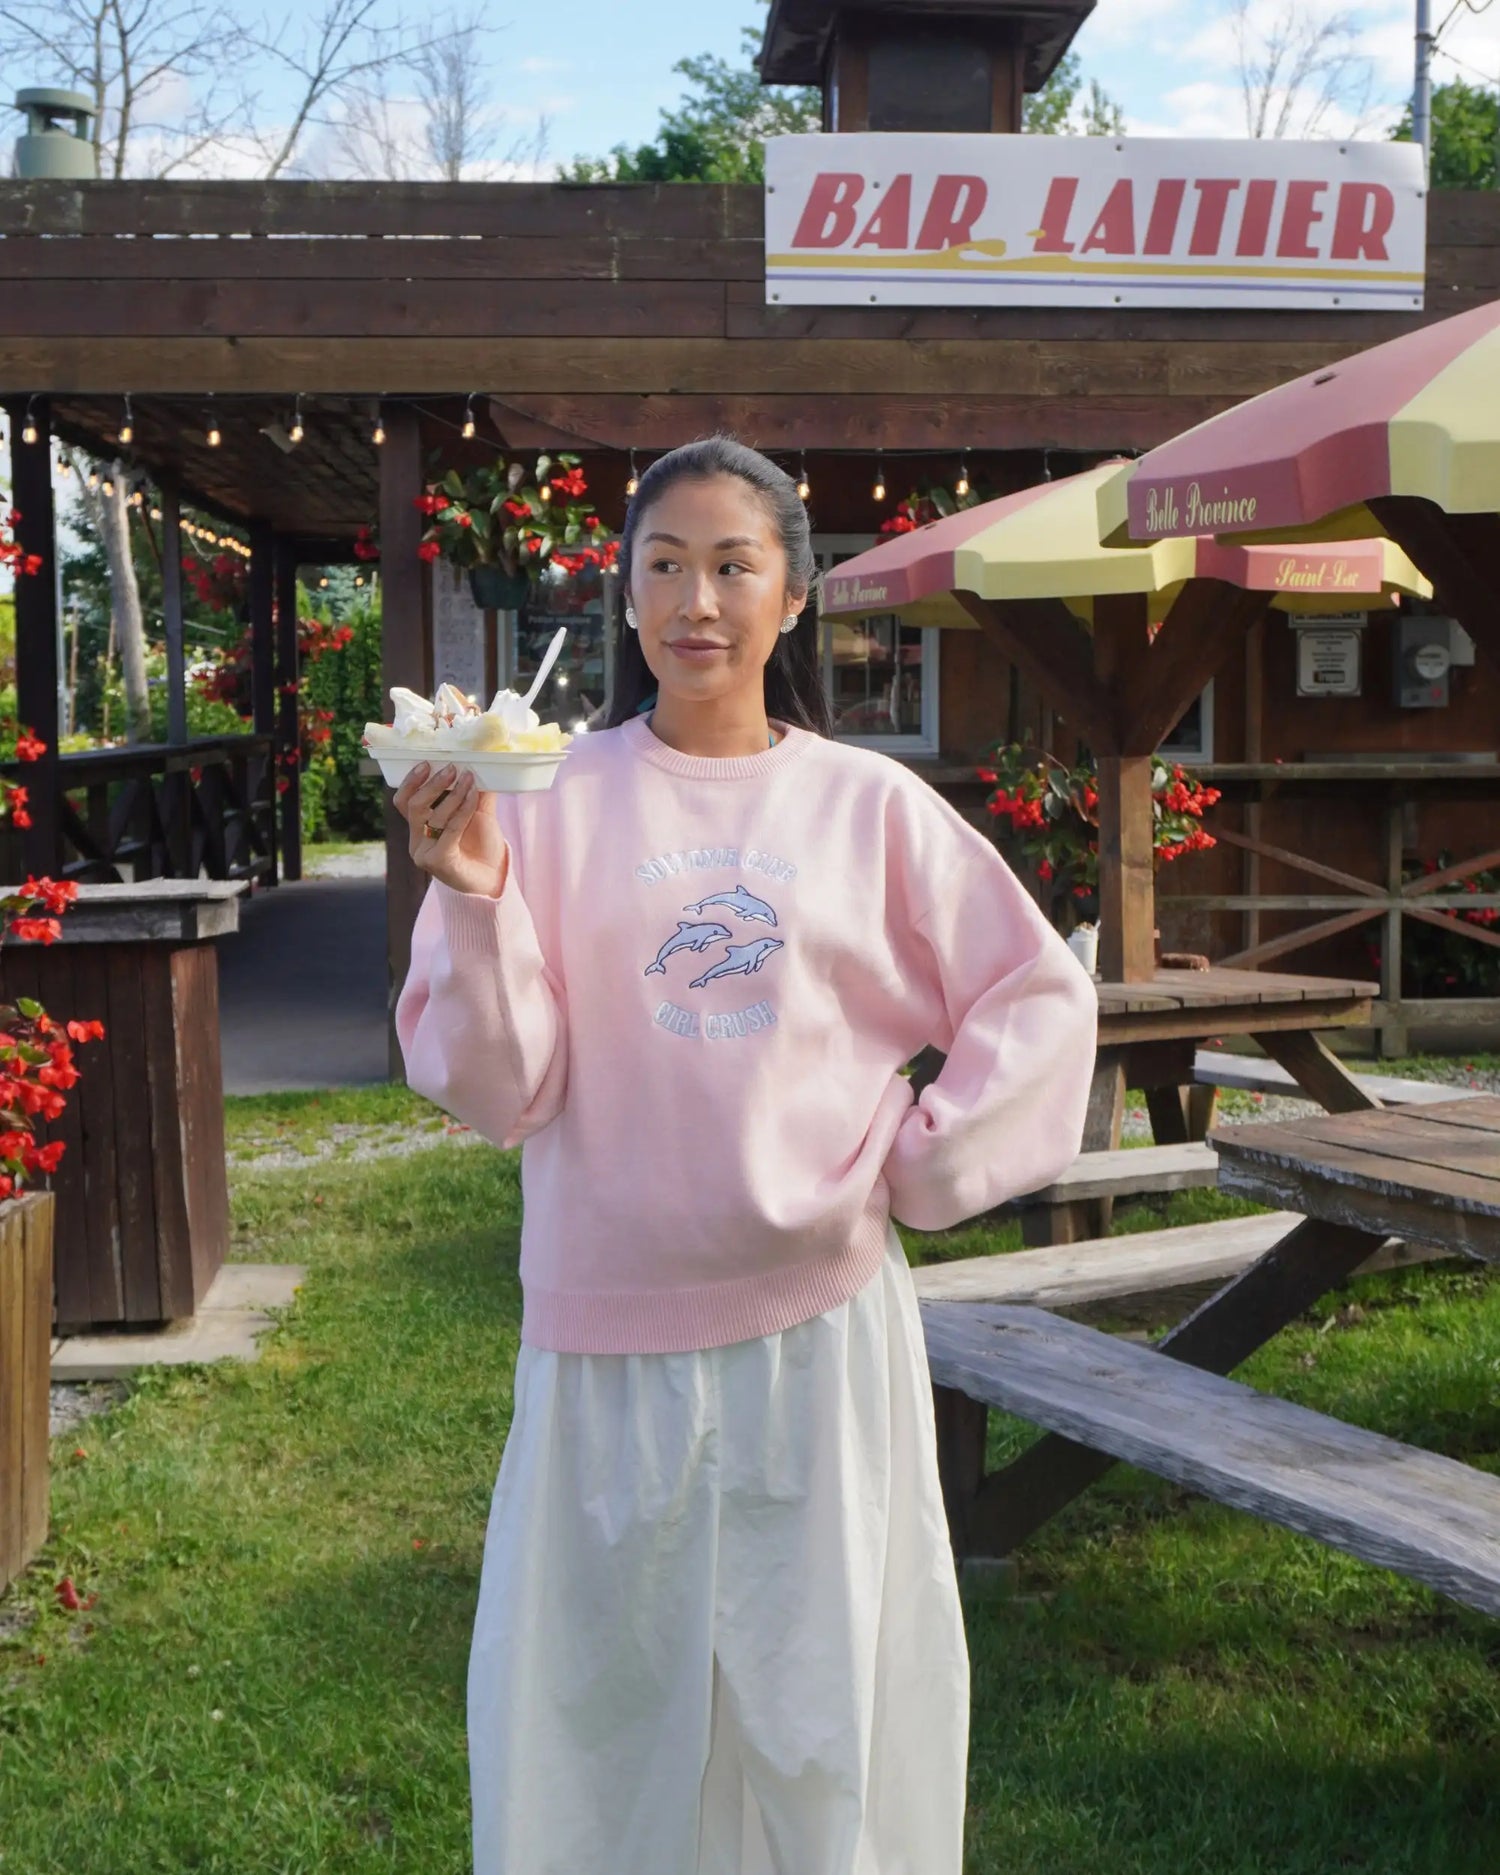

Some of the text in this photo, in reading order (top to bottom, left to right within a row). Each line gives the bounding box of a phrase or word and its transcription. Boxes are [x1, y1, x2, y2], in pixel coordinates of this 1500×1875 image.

[790, 172, 1395, 261] BAR LAITIER
[1146, 481, 1257, 532] Belle Province
[653, 999, 778, 1040] GIRL CRUSH
